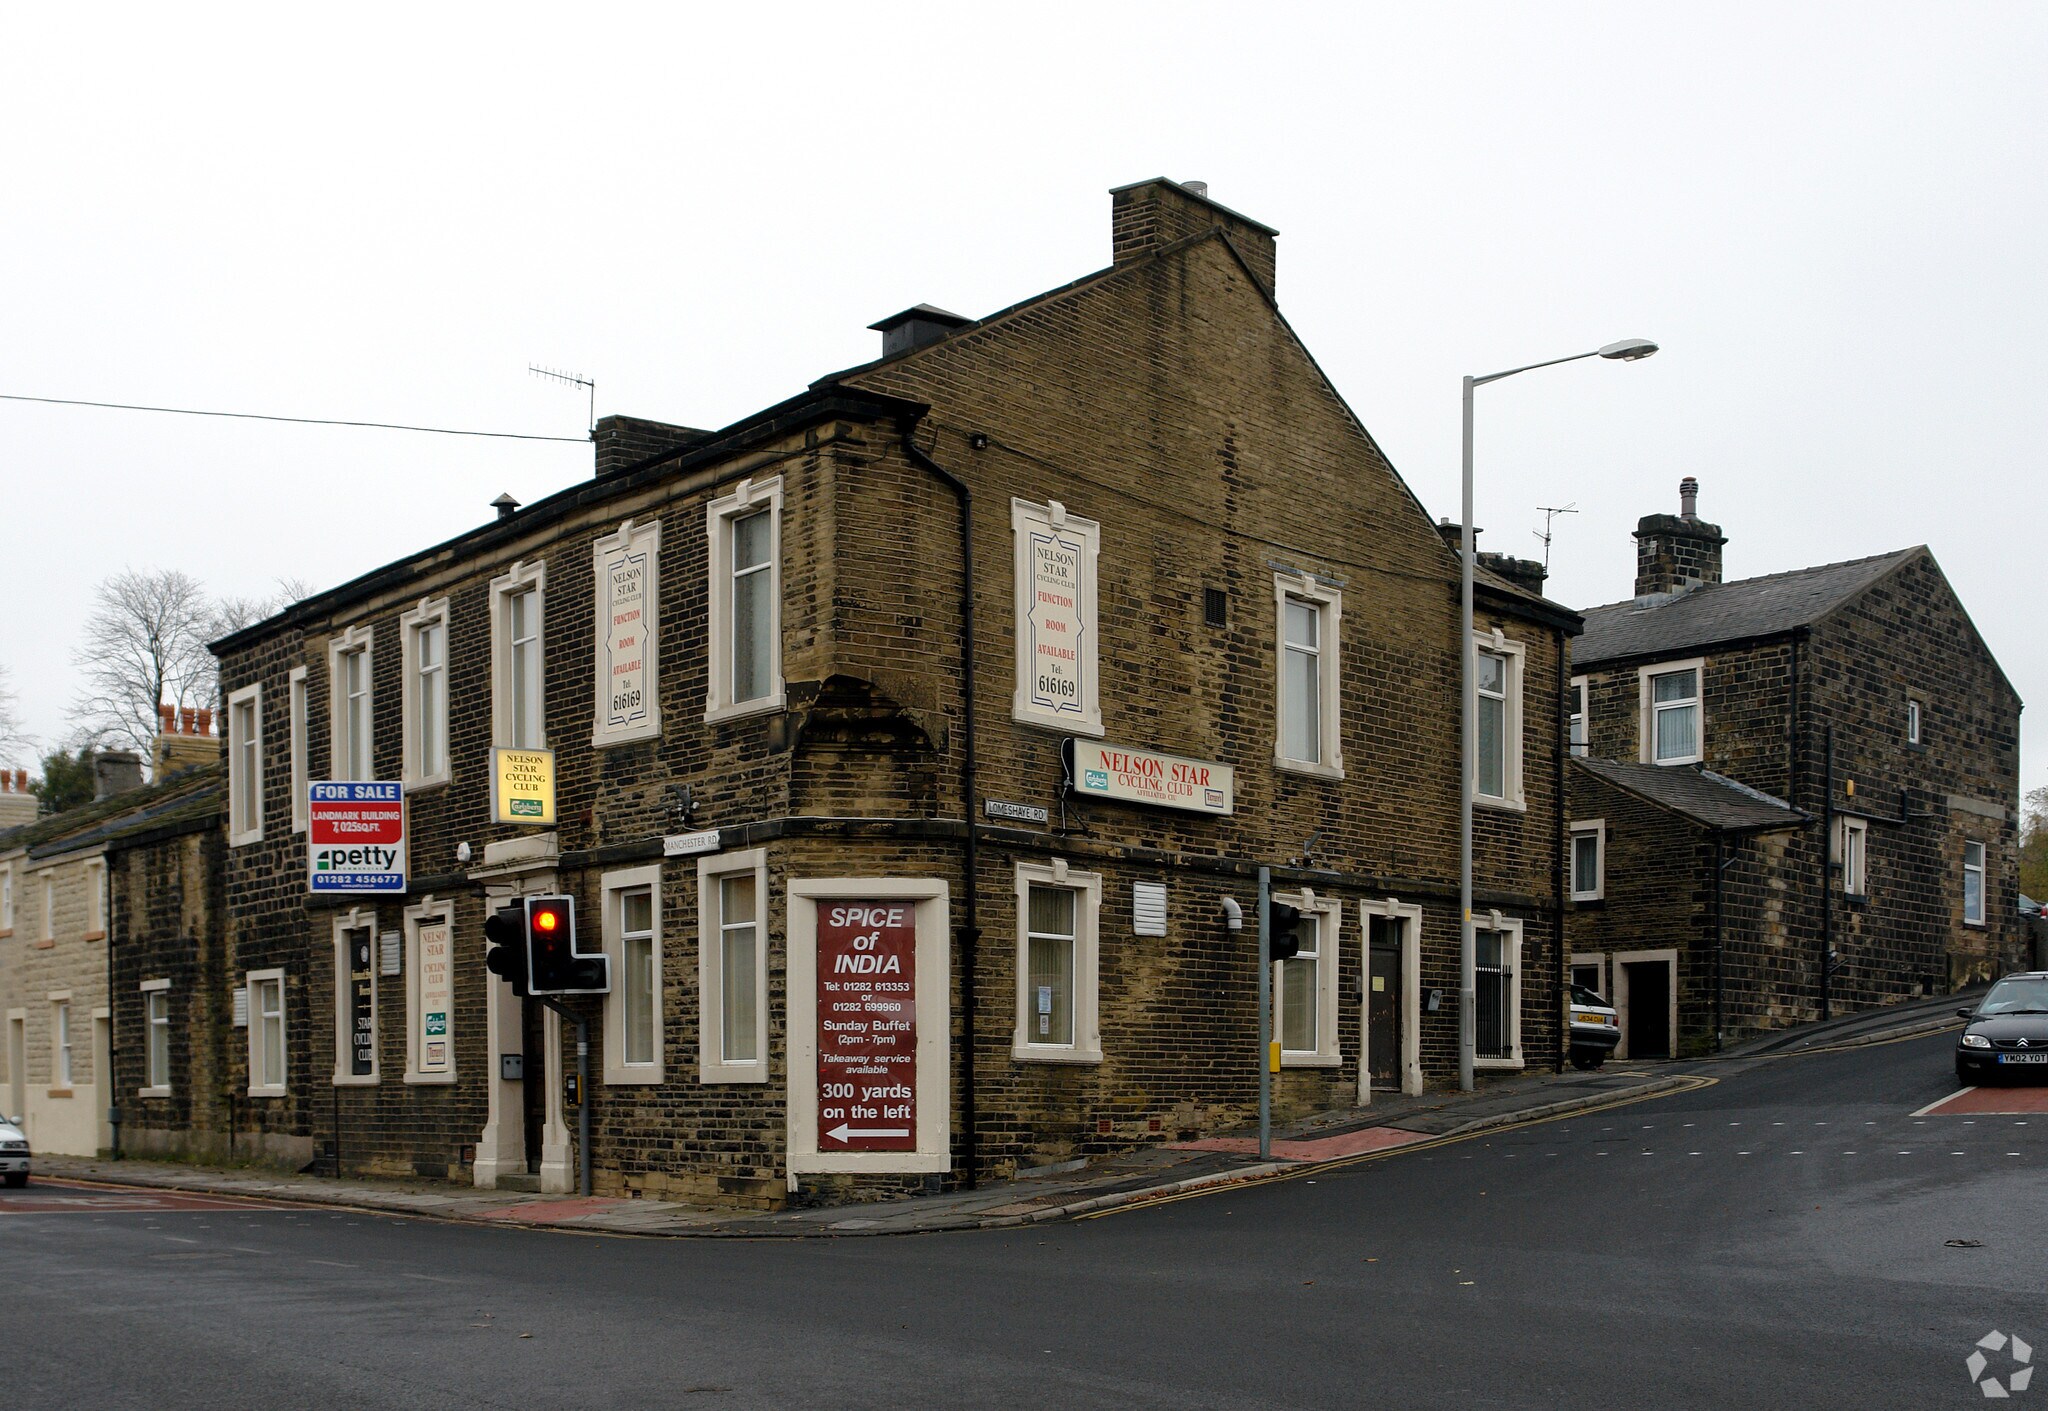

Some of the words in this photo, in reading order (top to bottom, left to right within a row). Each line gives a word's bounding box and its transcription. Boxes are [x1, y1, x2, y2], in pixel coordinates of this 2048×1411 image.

[1037, 547, 1075, 566] NELSON
[613, 567, 641, 586] NELSON
[1043, 562, 1068, 578] STAR
[617, 582, 636, 597] STAR
[1038, 591, 1073, 608] FUNCTION
[613, 609, 641, 626] FUNCTION
[1045, 619, 1067, 633] ROOM
[618, 636, 635, 649] ROOM
[1037, 644, 1076, 661] AVAILABLE
[612, 660, 641, 676] AVAILABLE
[1039, 675, 1075, 697] 616169
[613, 690, 641, 711] 616169
[507, 754, 543, 764] NELSON
[513, 764, 537, 773] STAR
[1099, 750, 1164, 779] NELSON
[1170, 762, 1210, 787] STAR
[505, 773, 546, 783] CYCLING
[1117, 773, 1163, 792] CYCLING
[1166, 781, 1193, 797] CLUB
[315, 785, 349, 799] FOR
[354, 785, 396, 799] SALE
[513, 782, 539, 791] CLUB
[511, 800, 541, 815] Carlsberg
[988, 802, 1031, 818] LOMESHAYE
[1033, 809, 1044, 820] RD
[312, 811, 359, 820] LANDMARK
[361, 811, 400, 821] BUILDING
[664, 836, 706, 851] MANCHESTER
[707, 835, 717, 845] RD
[331, 846, 397, 871] petty
[317, 875, 351, 884] 01282
[356, 875, 398, 884] 456677
[829, 907, 904, 928] SPICE
[853, 931, 880, 951] of
[427, 943, 444, 956] STAR
[834, 954, 901, 974] INDIA
[428, 973, 444, 984] CLUB
[824, 981, 840, 991] Tel:
[843, 982, 872, 992] 01282
[875, 982, 910, 992] 613353
[861, 994, 873, 1002] or
[833, 1003, 861, 1012] 01282
[864, 1003, 901, 1012] 699960
[823, 1020, 868, 1033] Sunday
[872, 1020, 911, 1031] Buffet
[838, 1035, 864, 1045] (2pm
[872, 1035, 896, 1045] 7pm)
[823, 1053, 870, 1065] Takeaway
[874, 1054, 911, 1063] service
[2004, 1054, 2027, 1063] YM02
[2029, 1054, 2046, 1063] YOT
[845, 1065, 889, 1074] available
[822, 1083, 854, 1099] 300
[861, 1083, 912, 1102] yards
[823, 1107, 845, 1119] on
[851, 1105, 878, 1119] the
[883, 1105, 911, 1119] left
